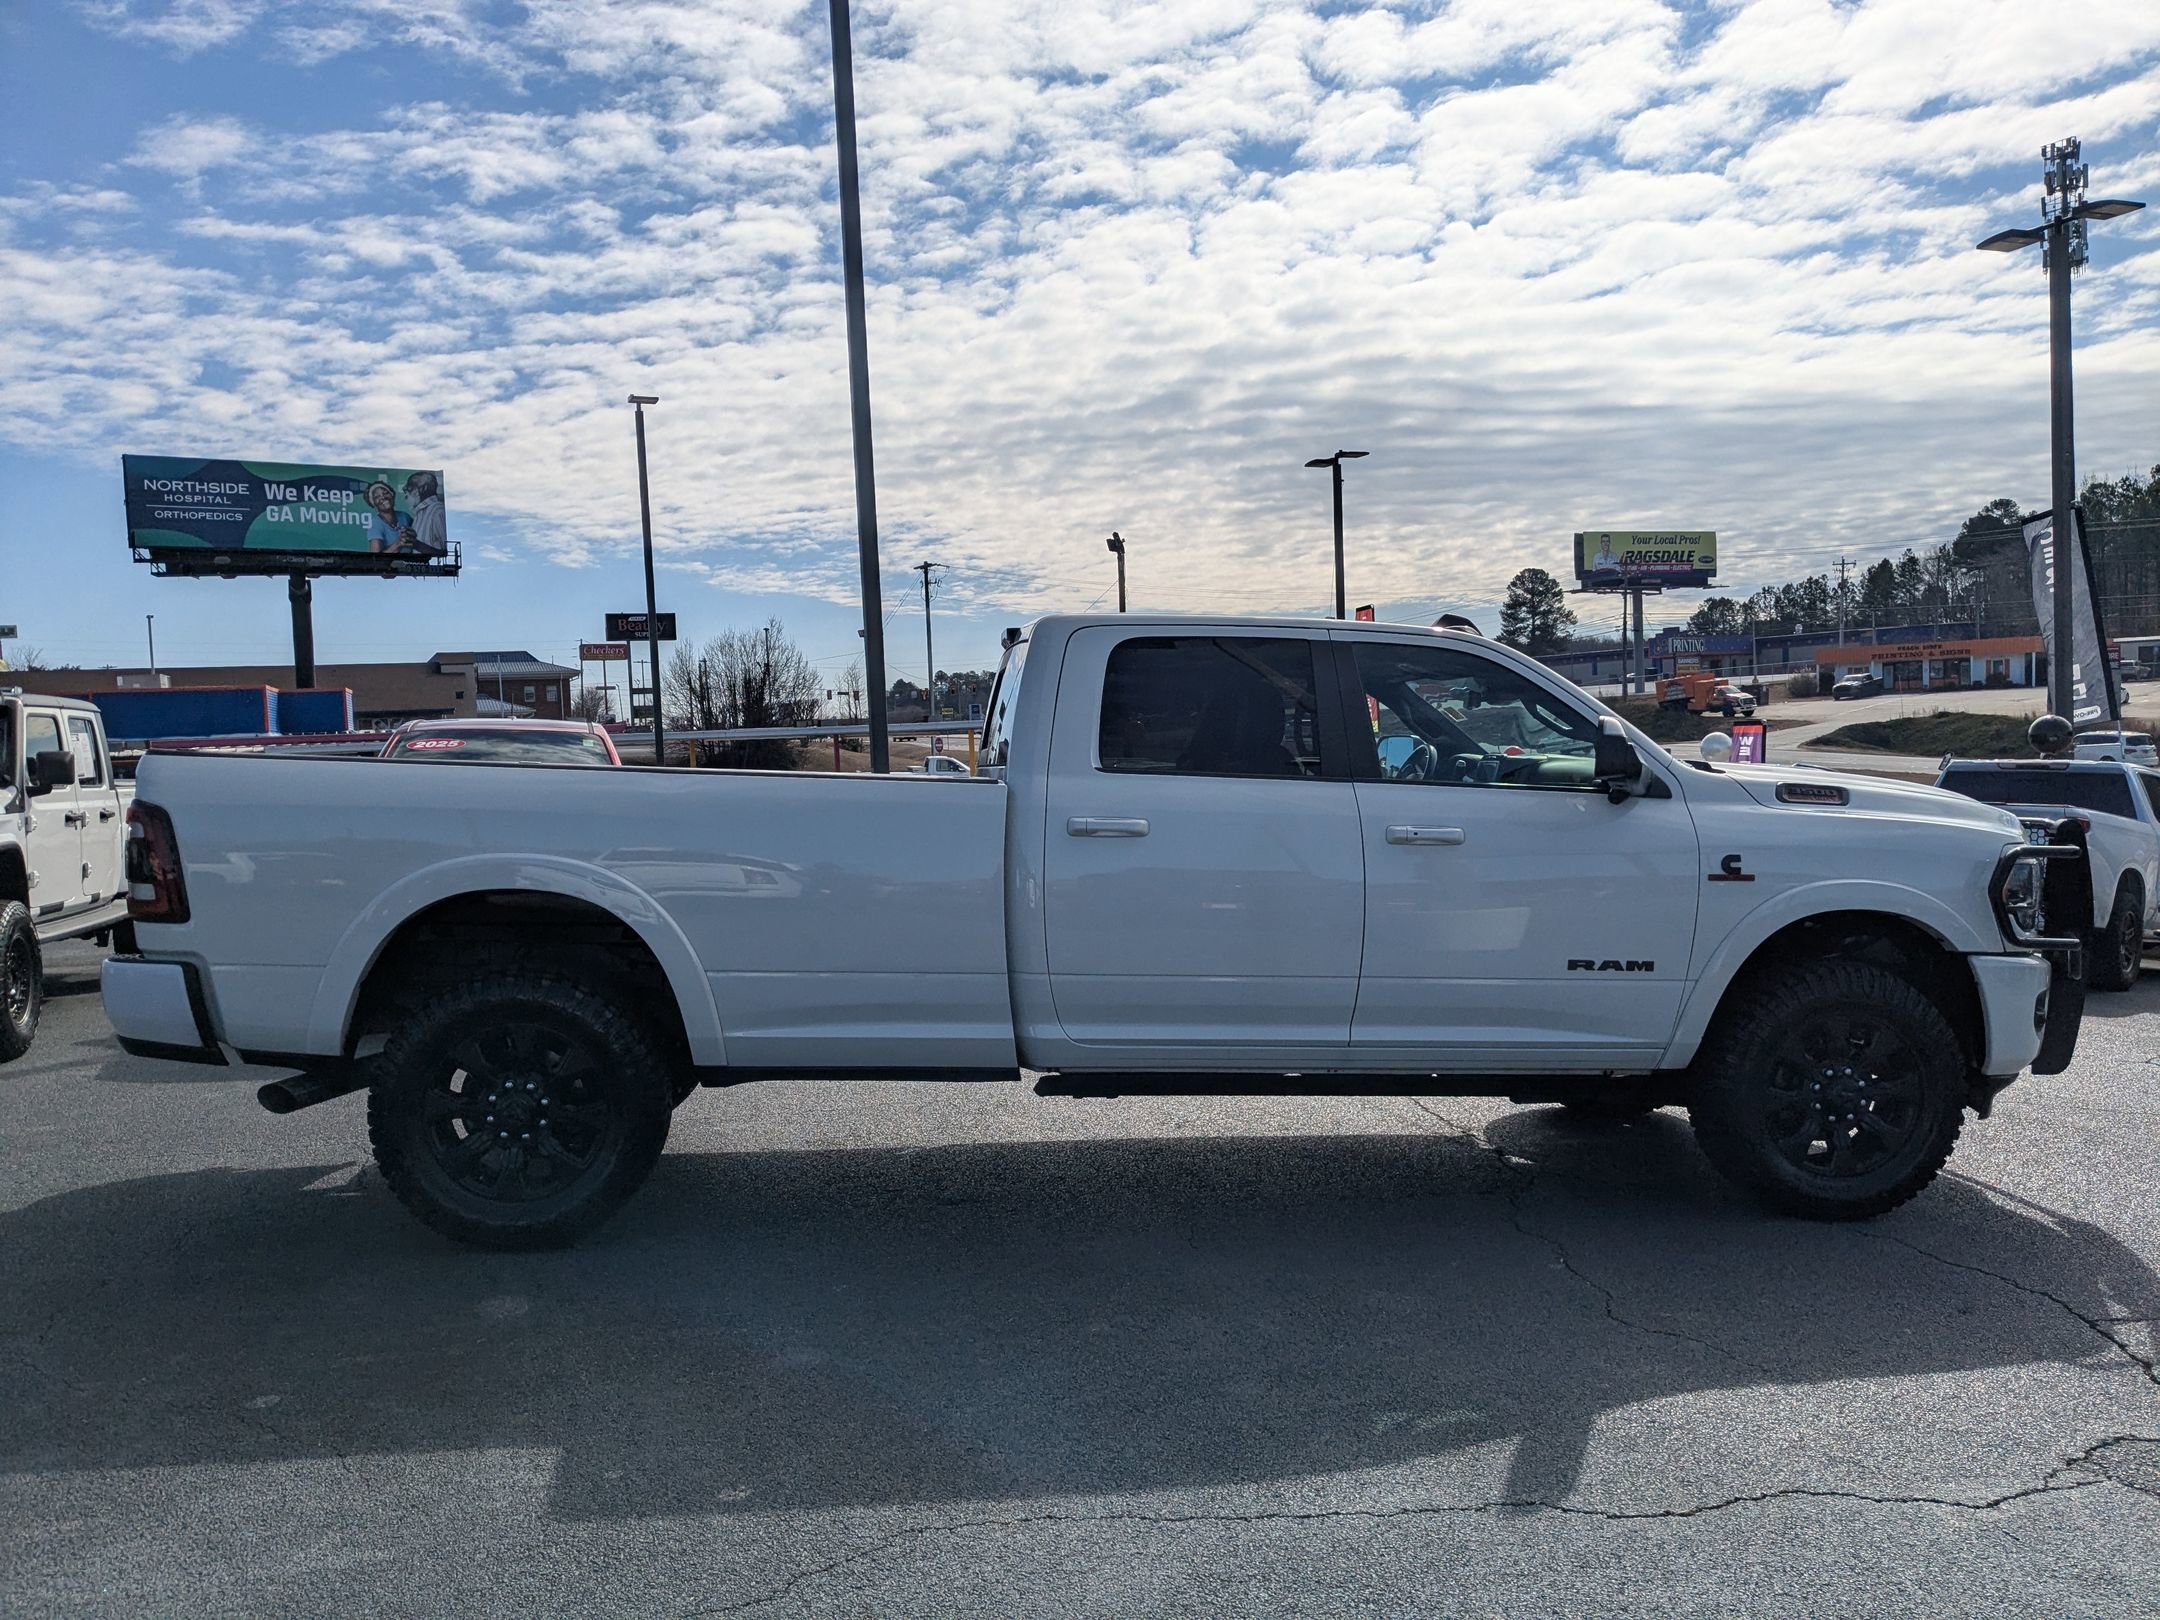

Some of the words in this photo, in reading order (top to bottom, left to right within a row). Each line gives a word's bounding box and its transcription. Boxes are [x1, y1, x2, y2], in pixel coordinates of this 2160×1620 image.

[144, 479, 250, 494] NORTHSIDE
[164, 494, 231, 504] HOSPITAL
[264, 483, 297, 501] We
[303, 485, 354, 506] Keep
[154, 510, 243, 520] ORTHOPEDICS
[266, 505, 294, 522] GA
[300, 507, 372, 529] Moving
[1632, 535, 1653, 545] Your
[1654, 535, 1677, 545] Local
[1679, 535, 1701, 545] Pros!
[1621, 550, 1695, 563] RAGSDALE
[618, 619, 665, 633] Beauy
[583, 646, 624, 654] Checkers
[1673, 639, 1704, 652] PRINTING
[414, 740, 458, 748] 2025
[1567, 959, 1655, 972] RAM
